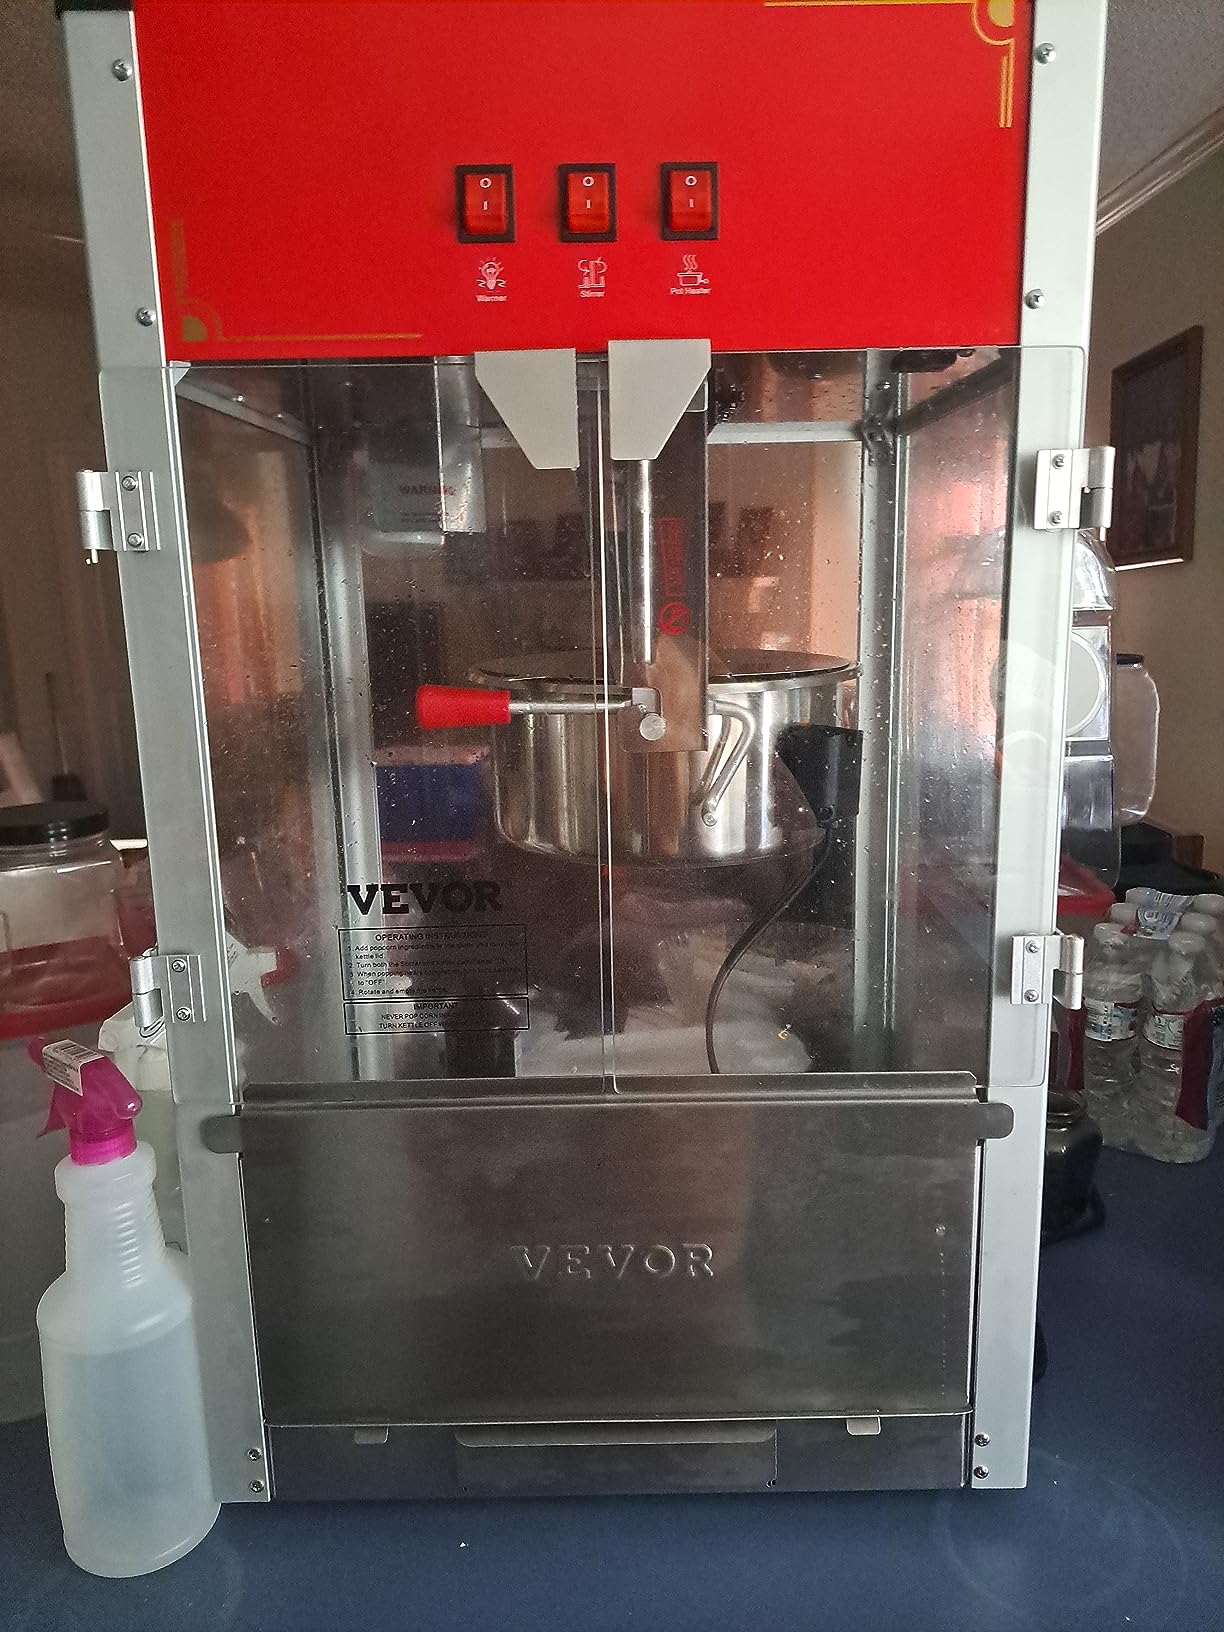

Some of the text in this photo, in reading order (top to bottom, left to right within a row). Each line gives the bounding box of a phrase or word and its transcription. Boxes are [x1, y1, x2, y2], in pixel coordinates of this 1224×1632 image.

[670, 287, 683, 295] Pot
[476, 294, 507, 302] Warmer
[347, 881, 502, 915] VEVOR
[375, 930, 488, 941] OPERATING INSTRUTIONS
[370, 944, 397, 952] popcorn
[414, 1002, 458, 1010] IMPORTANT
[509, 1244, 714, 1280] VEVOR
